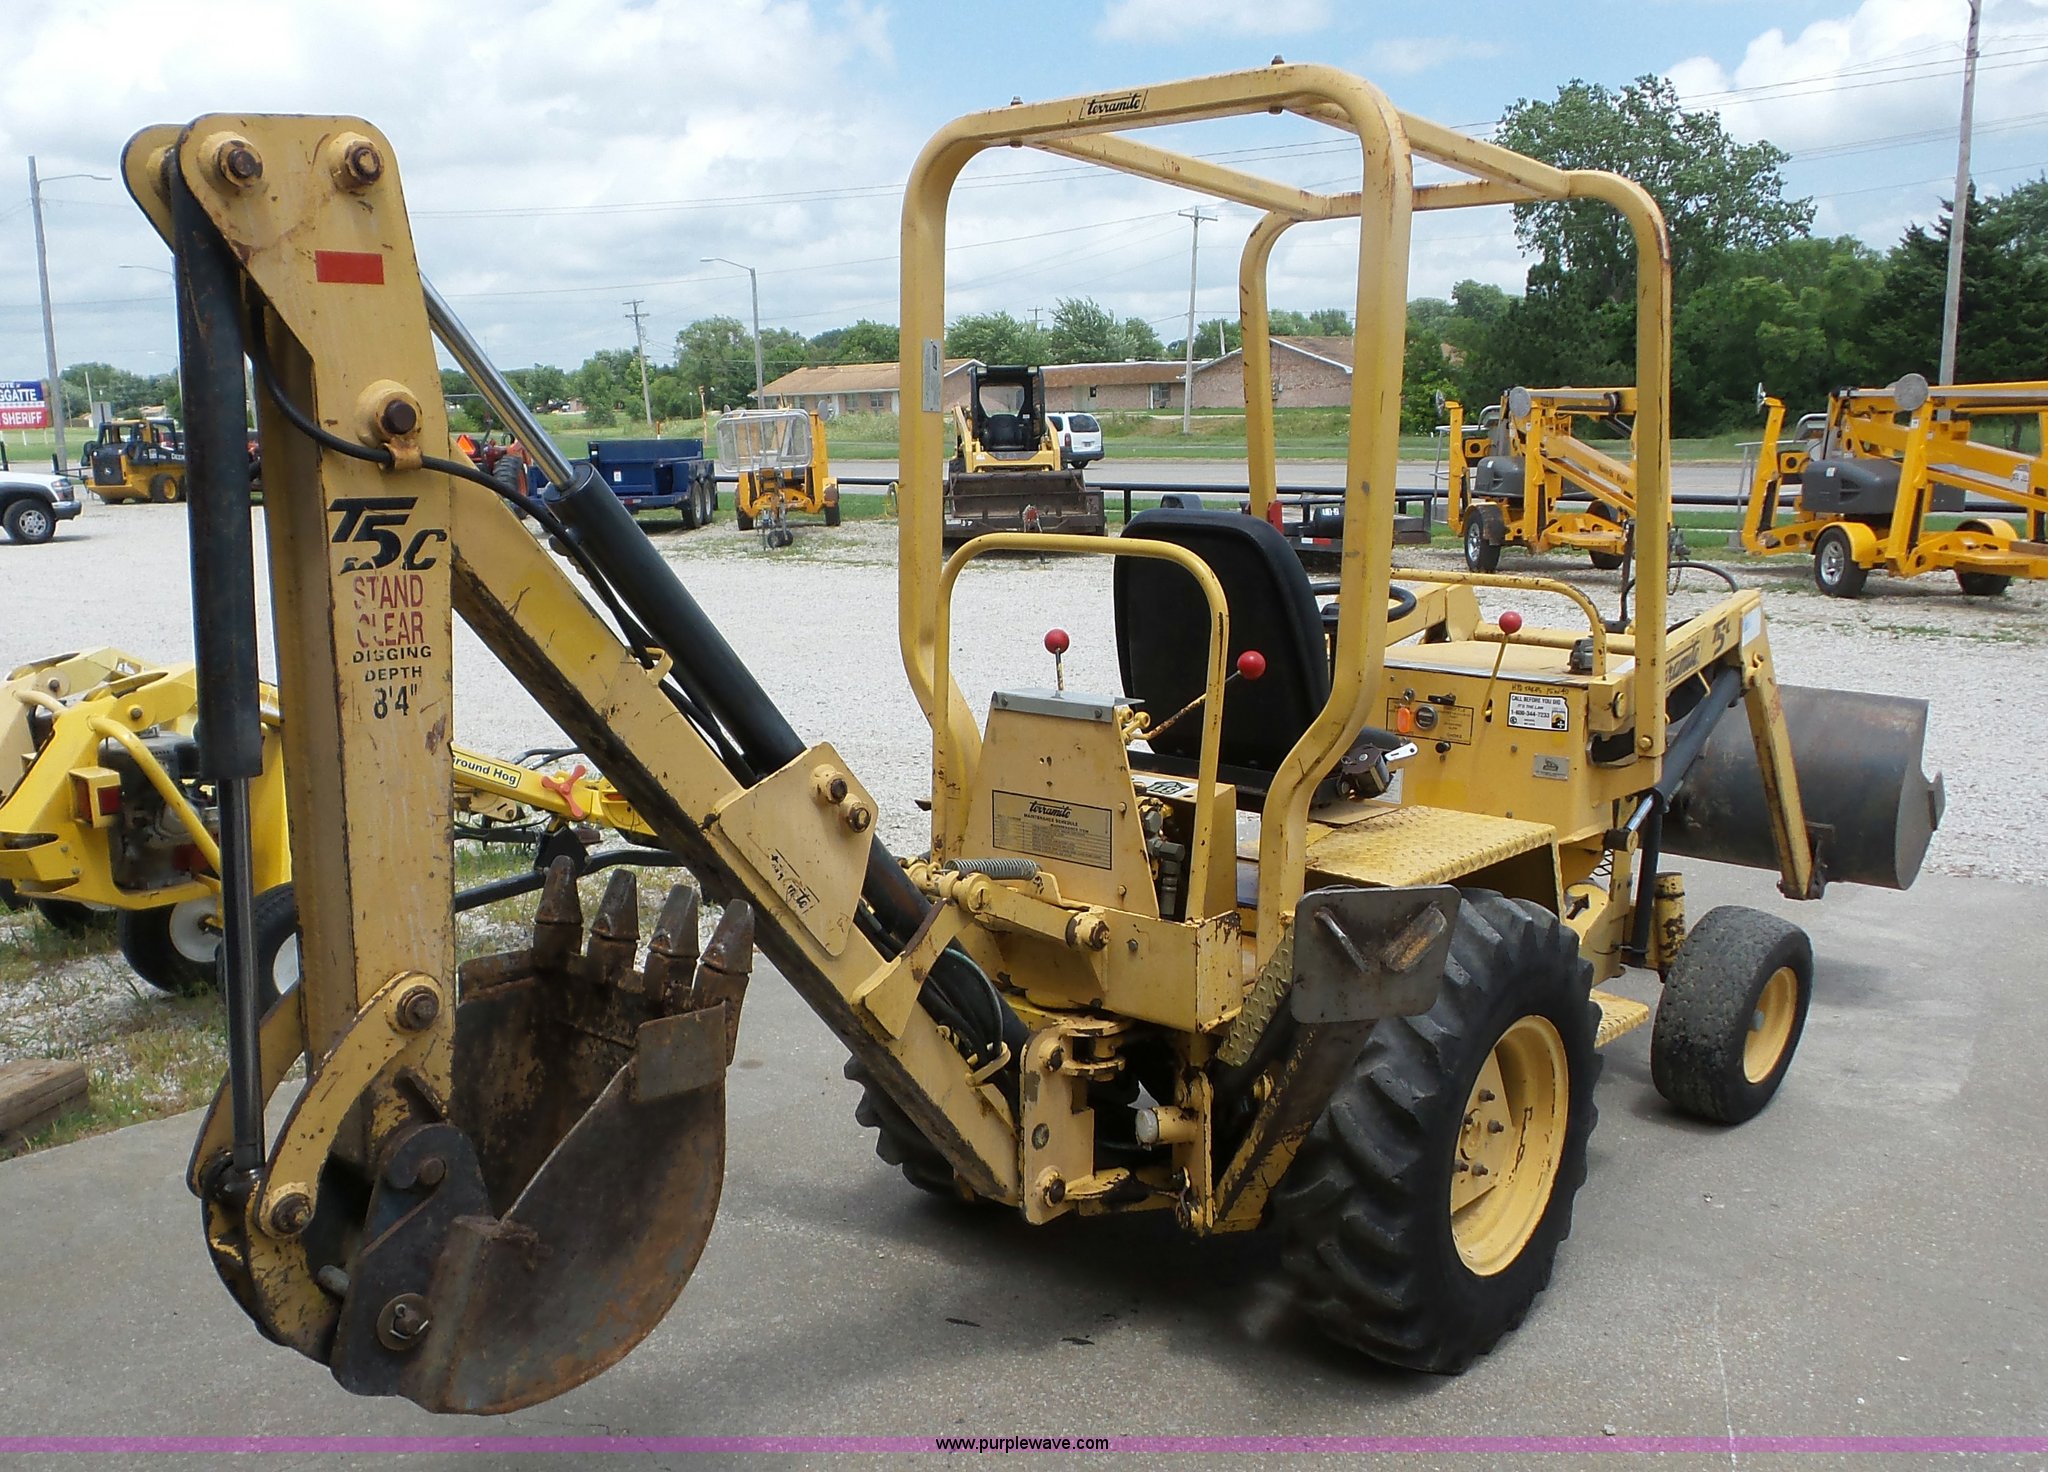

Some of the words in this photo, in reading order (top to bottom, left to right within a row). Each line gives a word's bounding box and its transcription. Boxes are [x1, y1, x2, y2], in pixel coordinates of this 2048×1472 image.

[1087, 93, 1141, 115] terramite
[2, 411, 42, 425] SHERIFF
[353, 574, 424, 610] STAND
[353, 645, 431, 663] DIGGING
[365, 665, 422, 682] DEPTH
[453, 757, 490, 775] round
[493, 768, 516, 785] Hog
